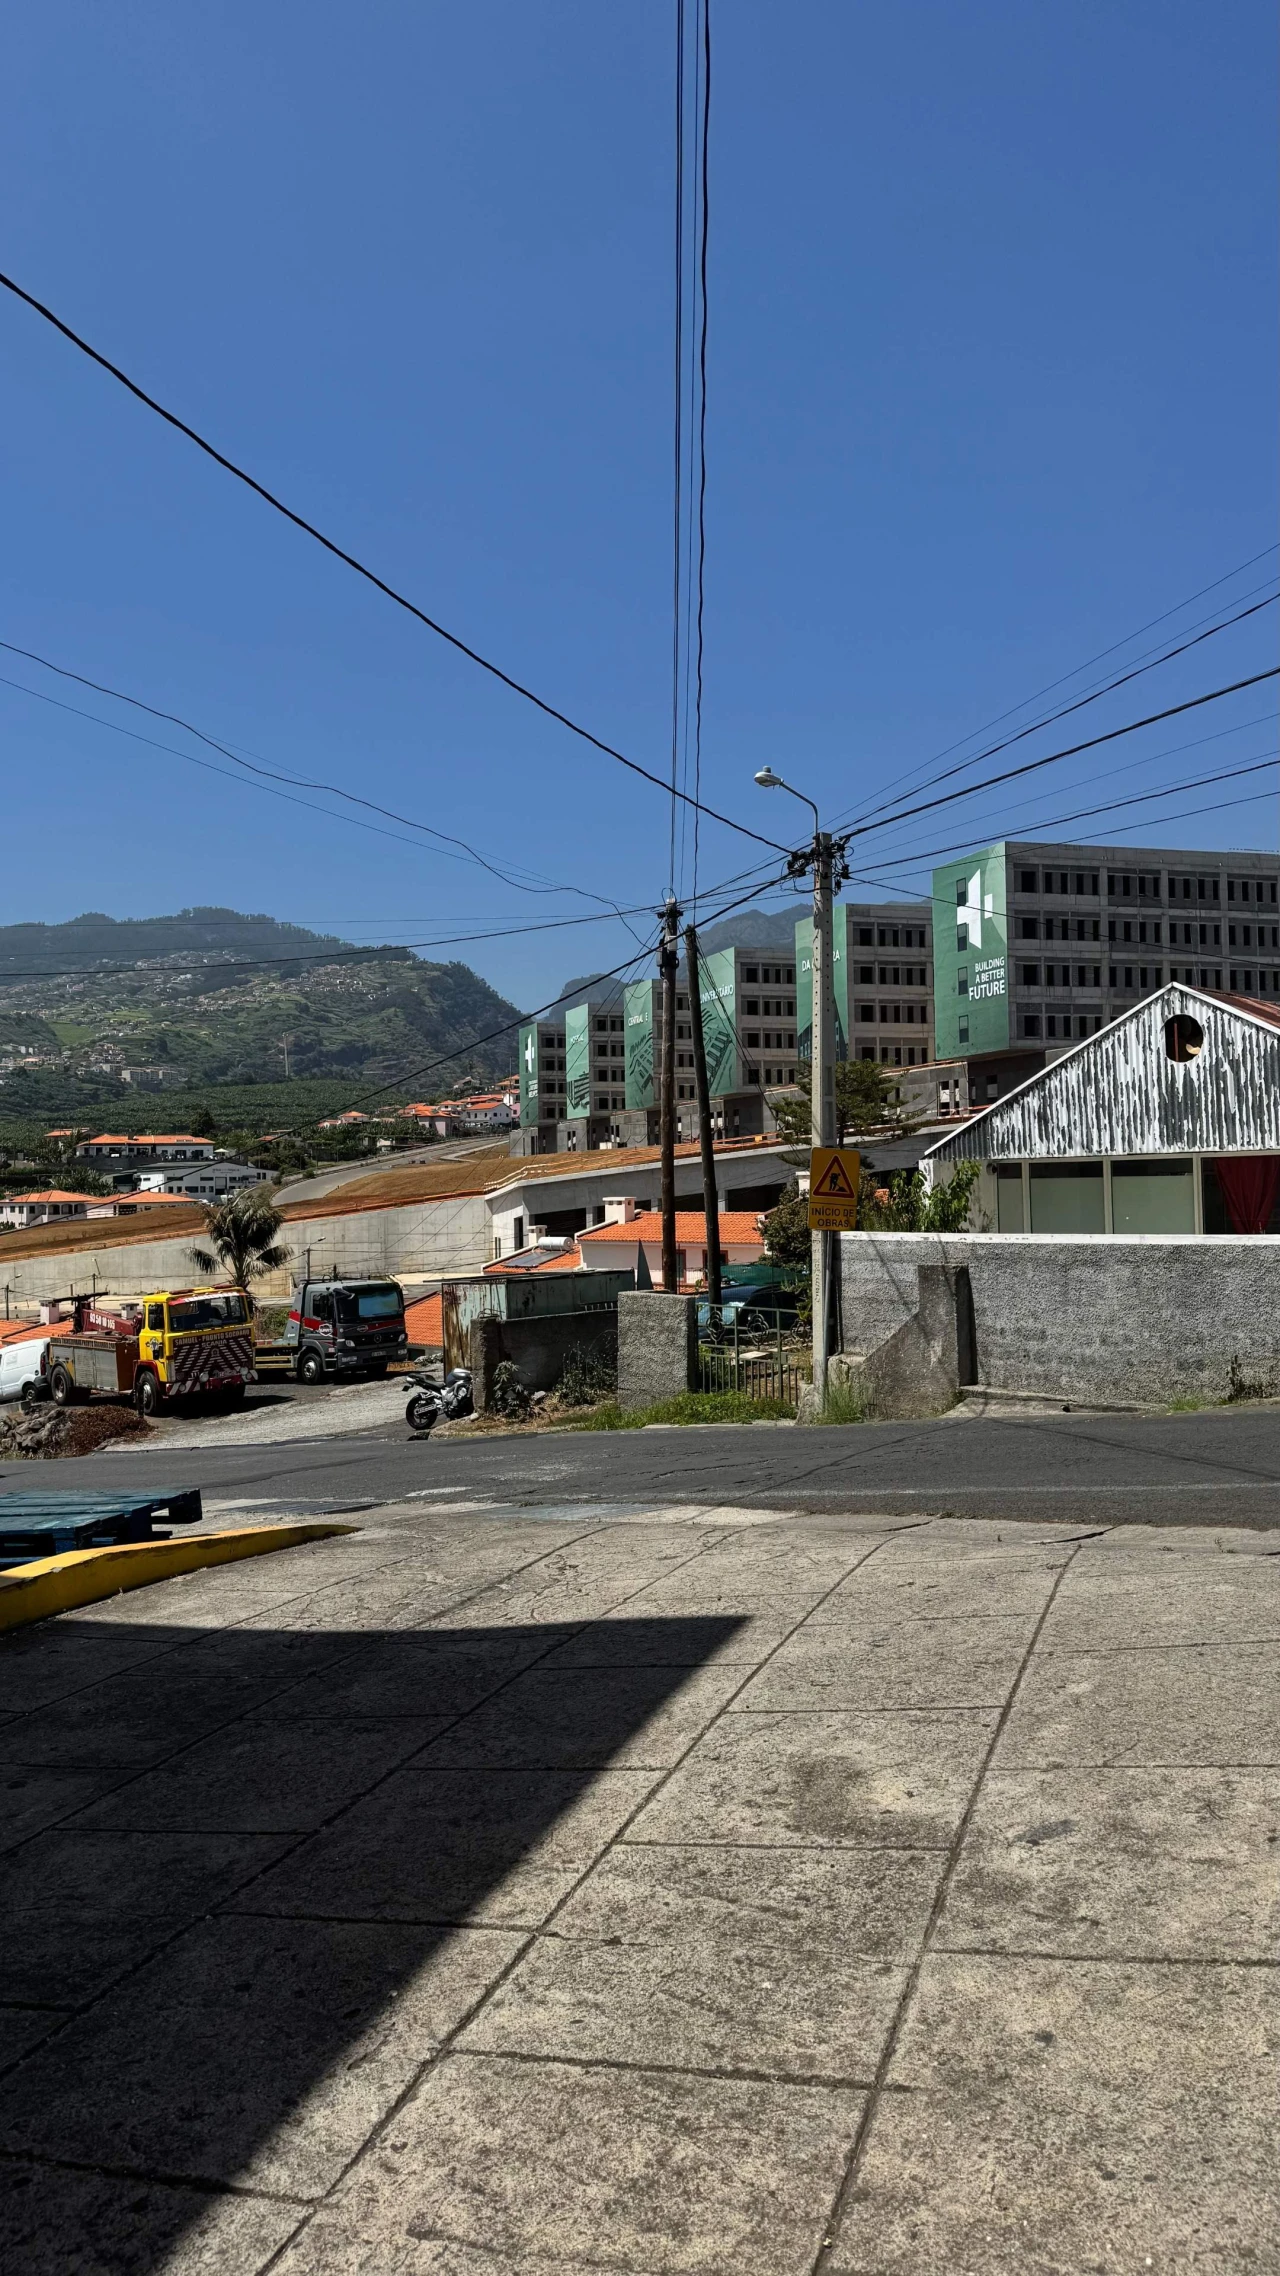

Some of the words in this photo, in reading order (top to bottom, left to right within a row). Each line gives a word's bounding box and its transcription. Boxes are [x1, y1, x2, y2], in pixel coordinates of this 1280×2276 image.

[802, 959, 811, 972] DA
[975, 956, 1005, 973] BUILDING
[975, 974, 981, 984] A
[981, 968, 1005, 983] BETTER
[968, 979, 1006, 1001] FUTURE
[811, 1205, 841, 1217] INÍCIO
[842, 1208, 855, 1217] DE
[817, 1218, 850, 1228] OBRAS
[174, 1336, 198, 1346] SAMUEL
[201, 1339, 227, 1348] SCANIA
